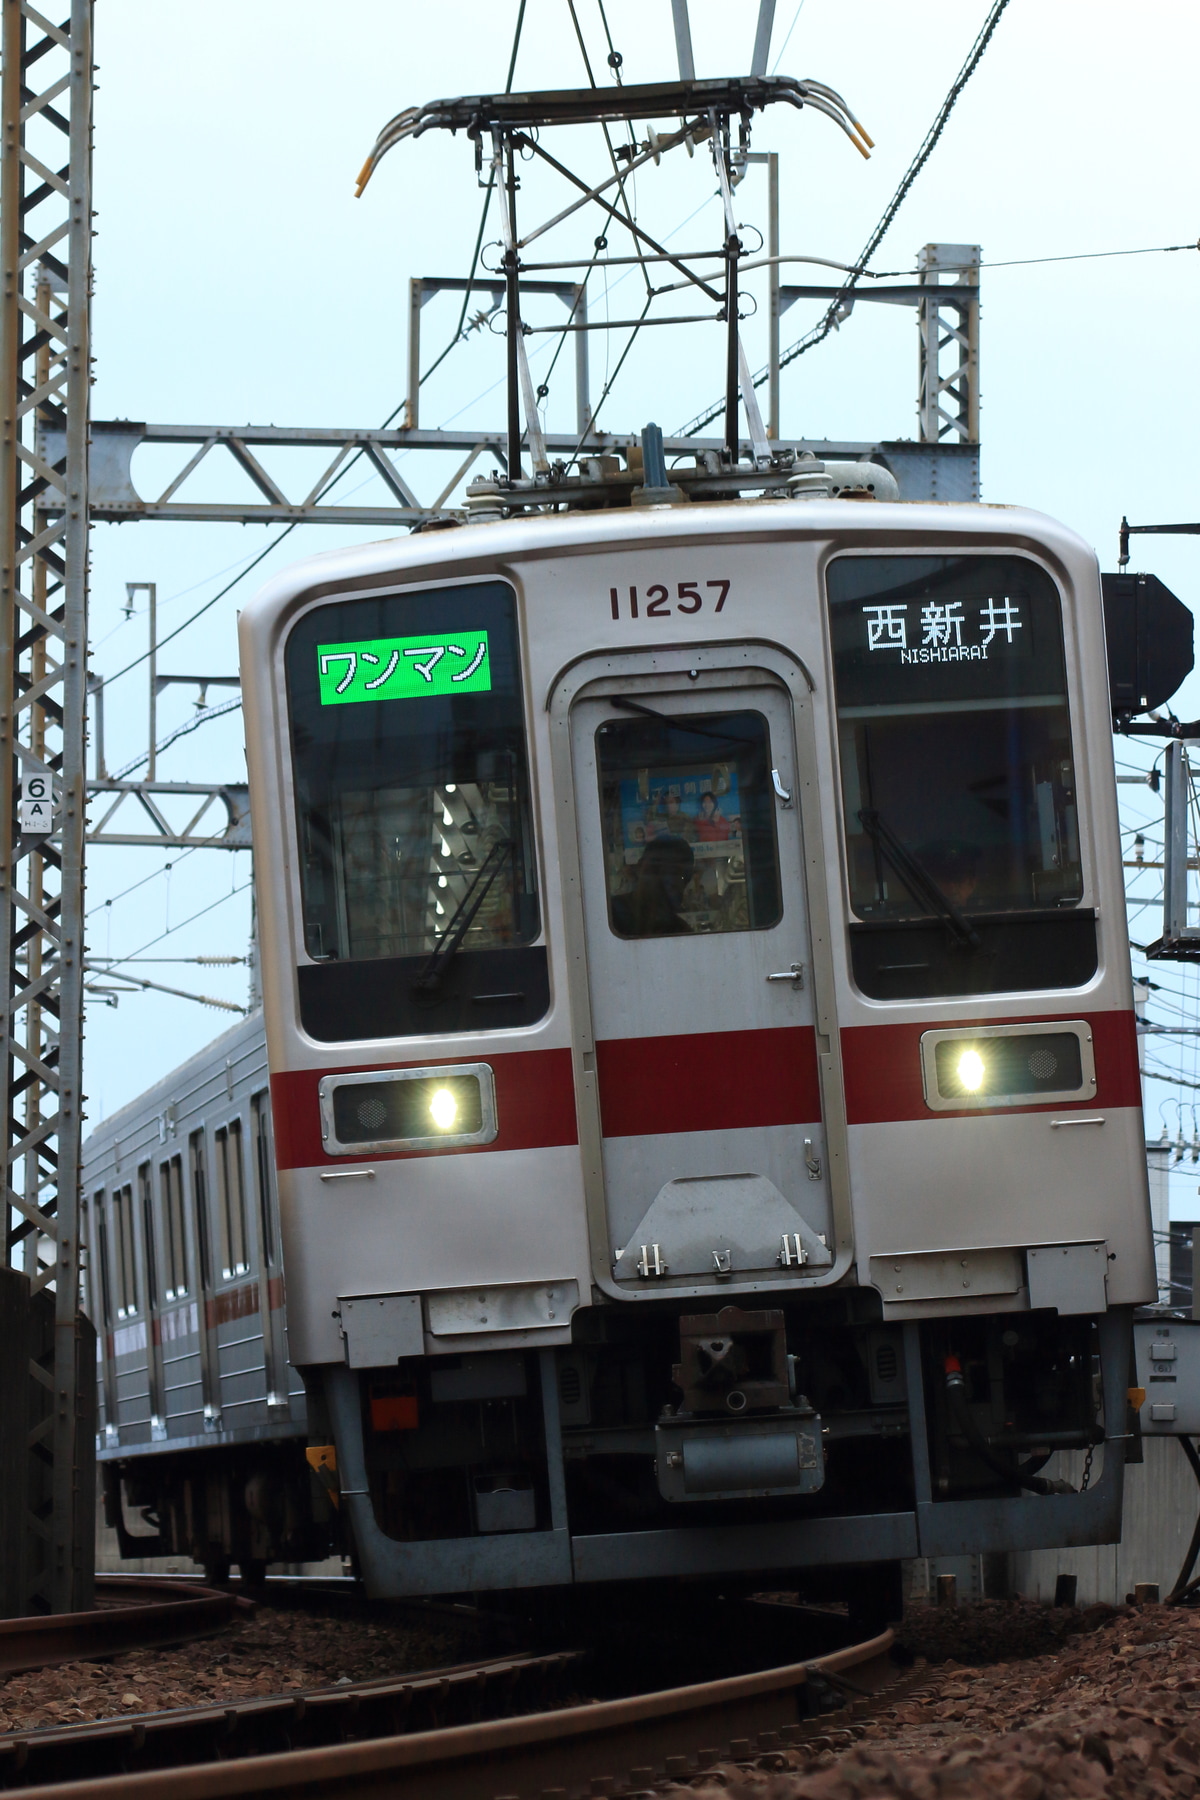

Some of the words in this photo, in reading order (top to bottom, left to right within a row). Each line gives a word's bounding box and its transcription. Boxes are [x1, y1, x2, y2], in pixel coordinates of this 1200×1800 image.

[609, 579, 731, 620] 11257
[862, 596, 1023, 651] 西新井
[320, 641, 486, 694] ワンマン
[900, 644, 988, 664] NISHIARAI
[28, 778, 45, 798] 6
[31, 803, 43, 815] A
